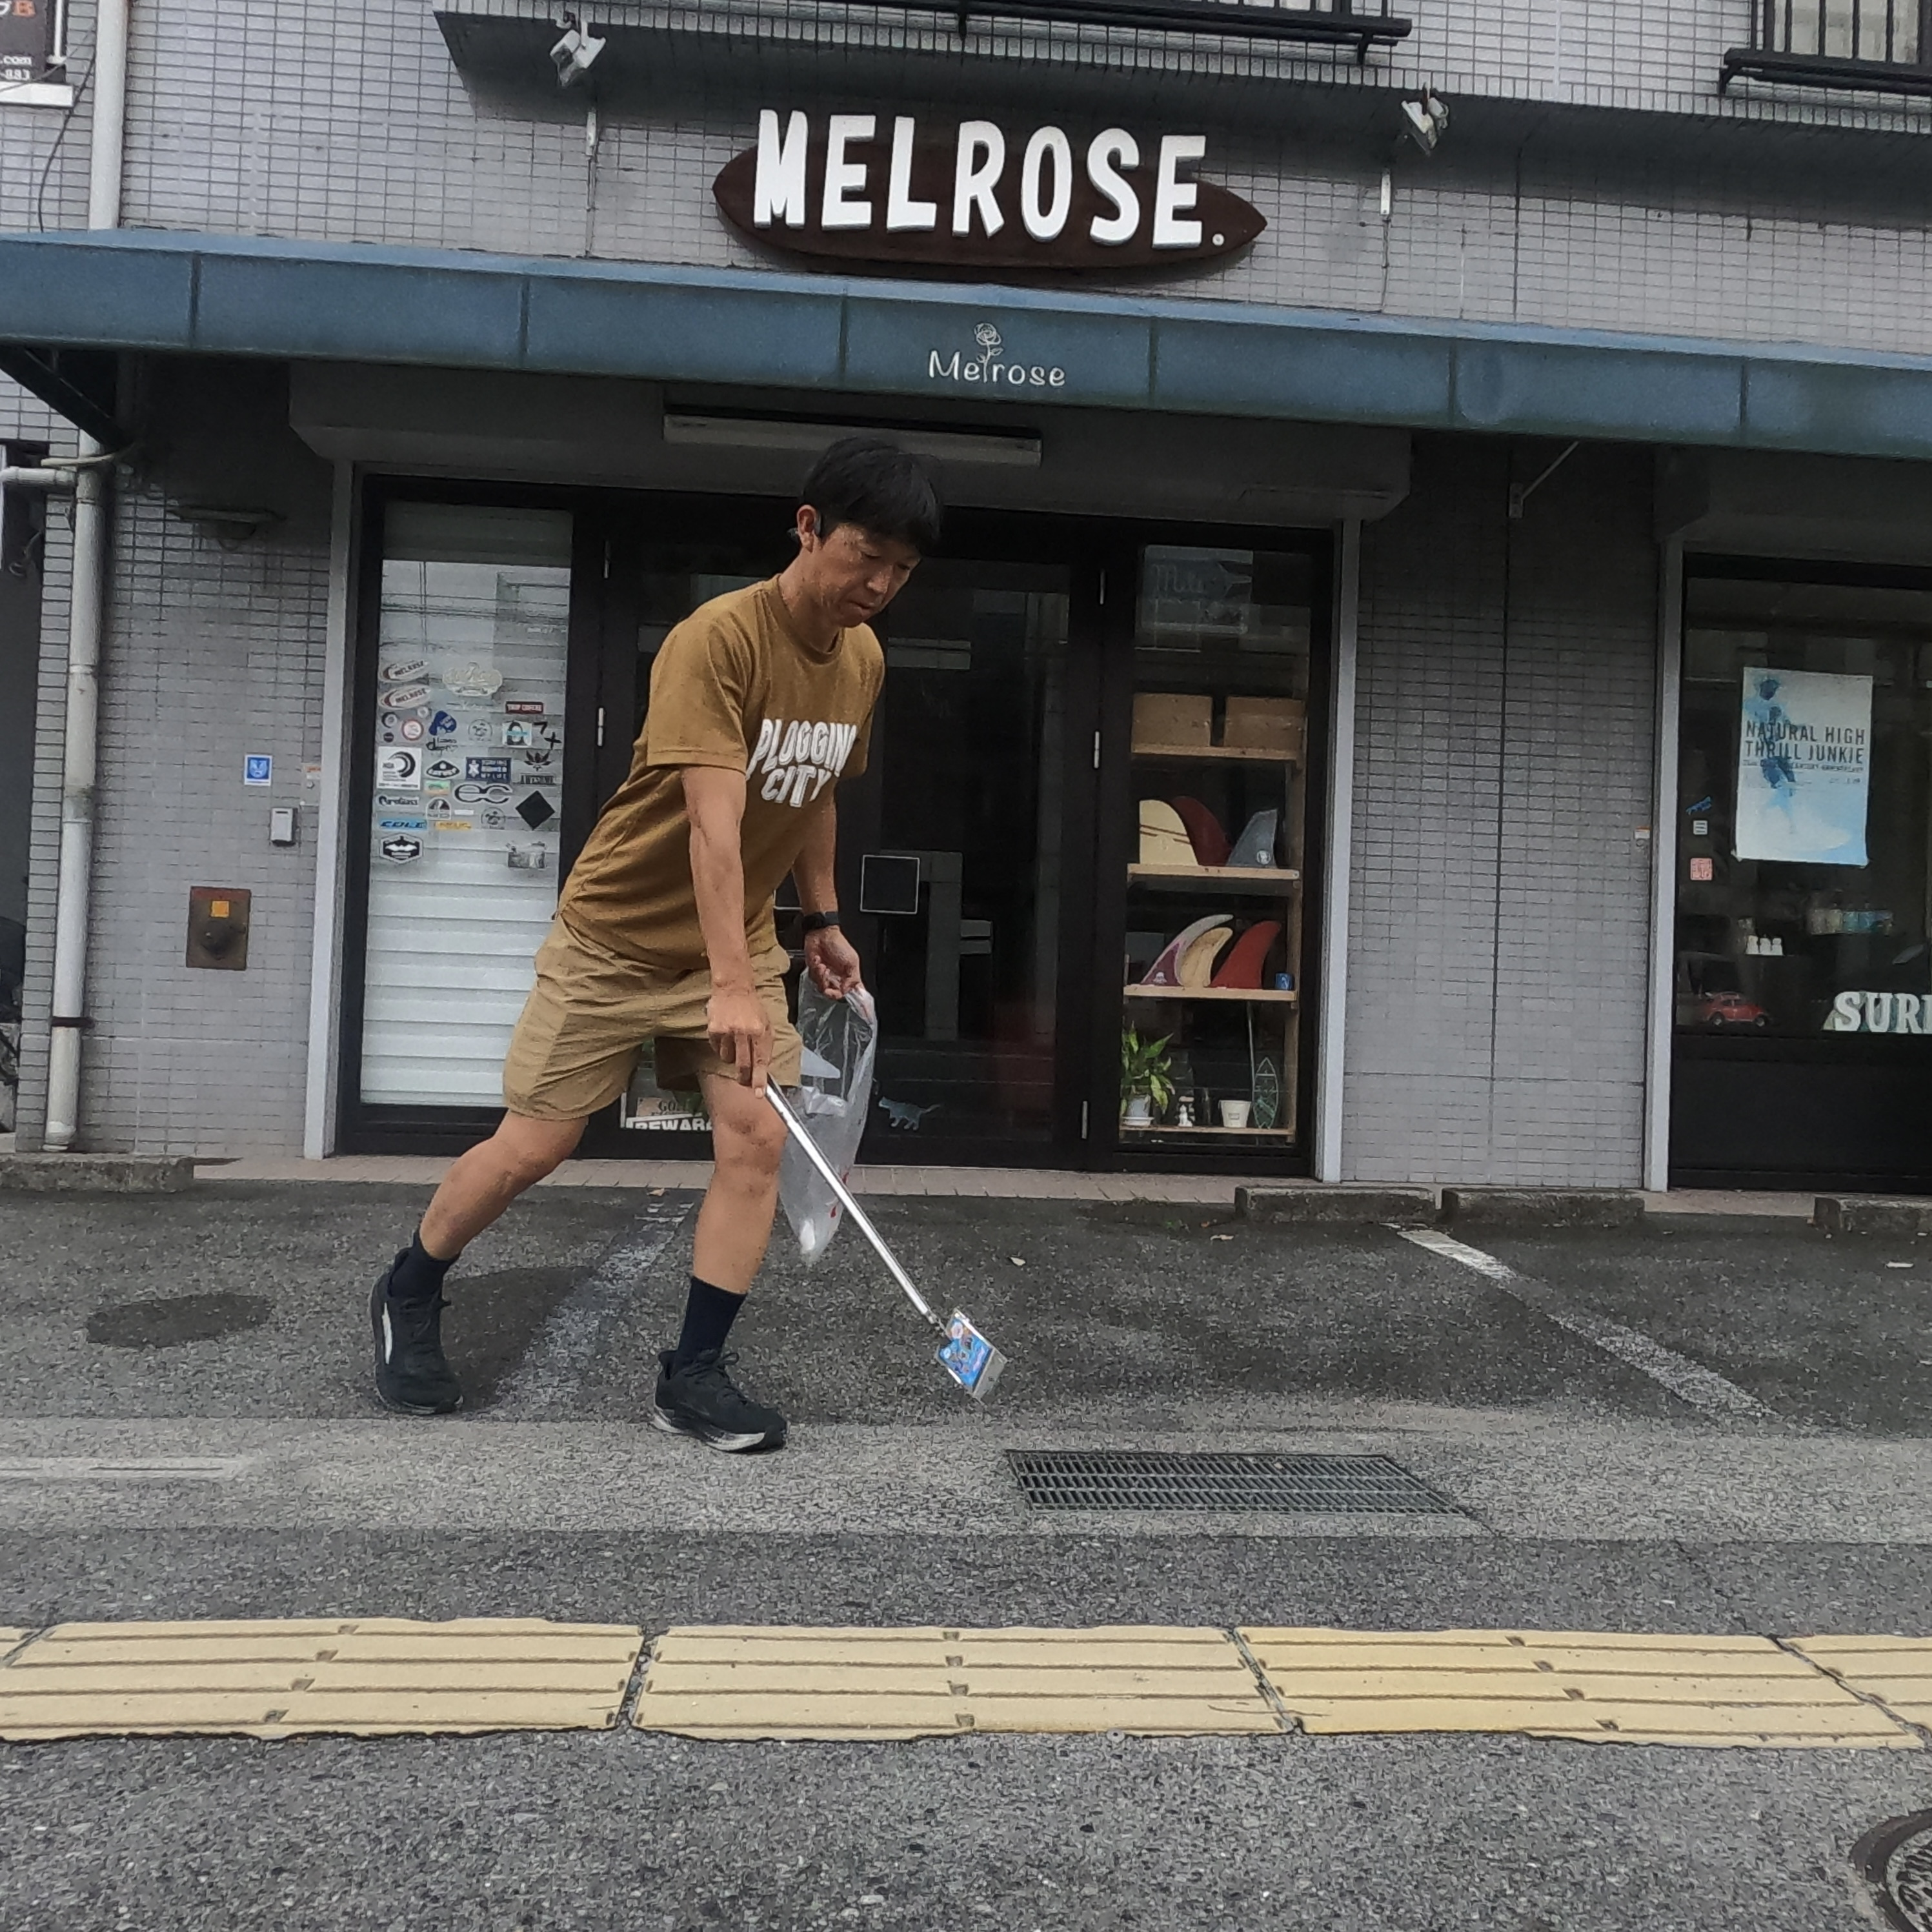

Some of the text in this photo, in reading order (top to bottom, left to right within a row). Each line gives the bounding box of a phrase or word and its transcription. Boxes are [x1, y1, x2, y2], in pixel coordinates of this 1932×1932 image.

[929, 350, 1065, 387] Melrose
[1746, 720, 1865, 745] NATURAL HIGH
[1745, 740, 1864, 765] THRILL JUNKIE
[761, 765, 832, 807] CITY
